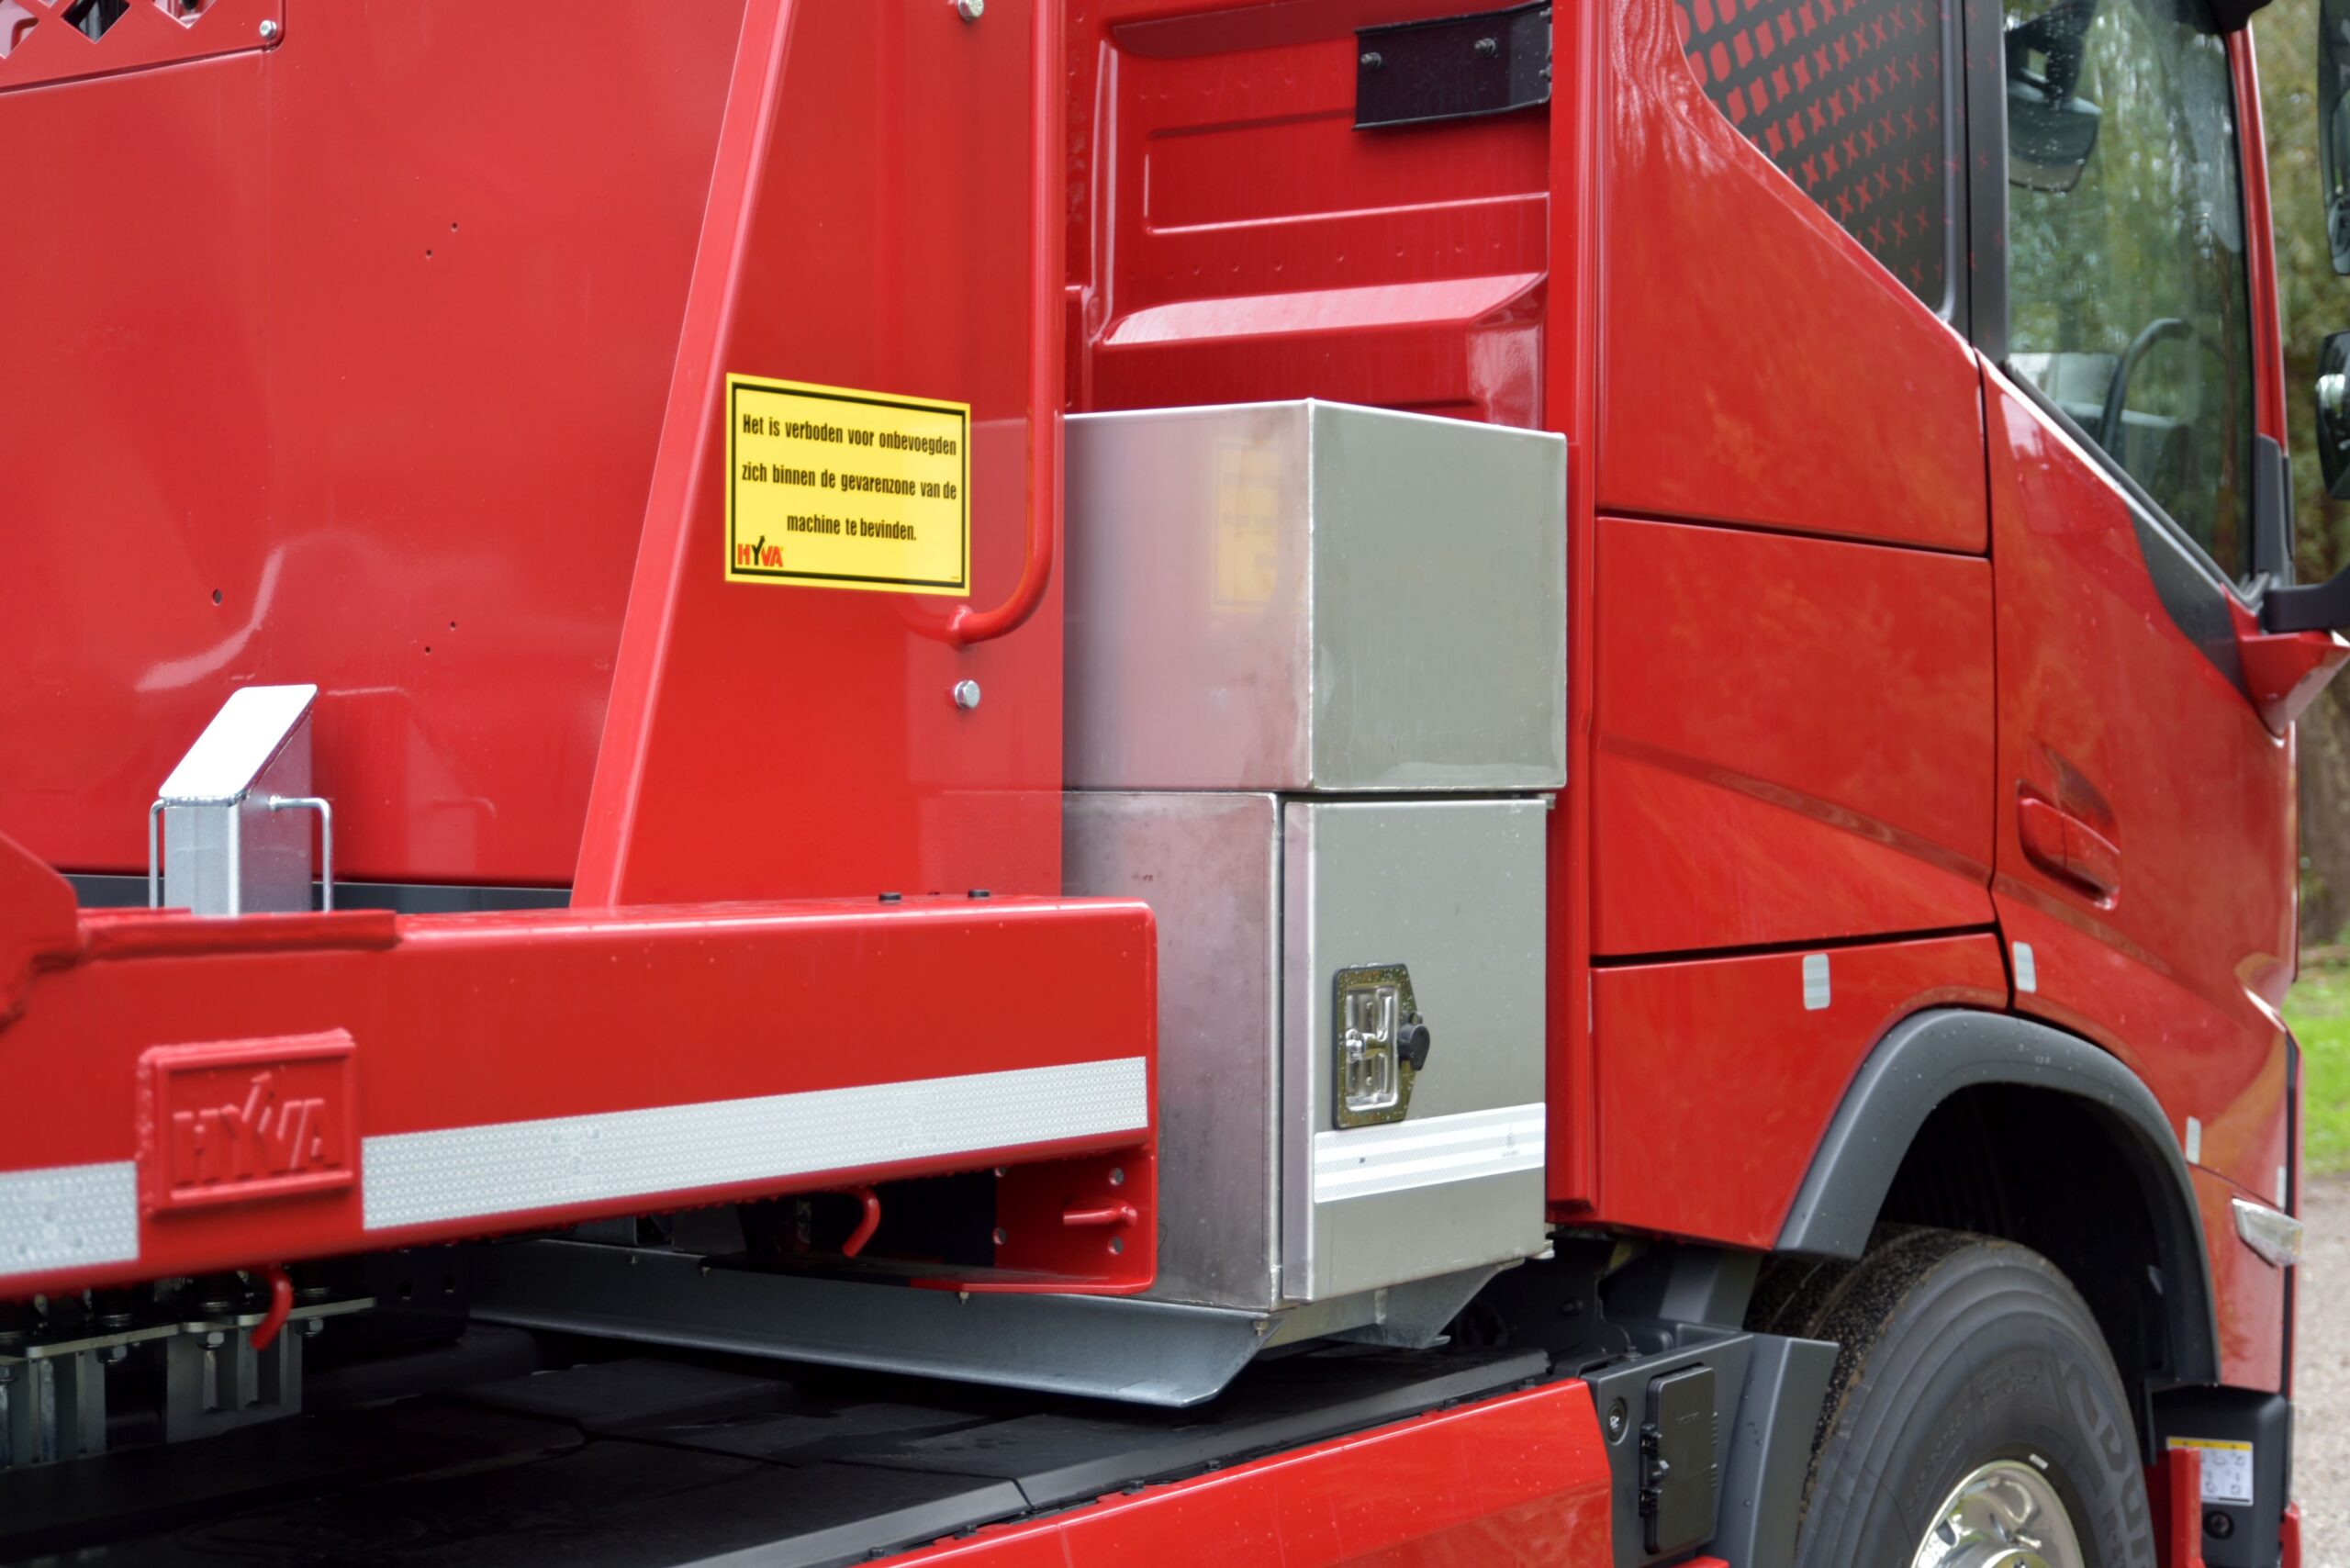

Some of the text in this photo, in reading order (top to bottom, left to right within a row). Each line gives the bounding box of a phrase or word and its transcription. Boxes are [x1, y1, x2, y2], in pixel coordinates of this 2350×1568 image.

[743, 413, 957, 455] Het is verboden voor onbevoegden
[741, 461, 957, 500] zich binnen de gevarenzone van de
[787, 514, 917, 542] machine te bevinden.
[737, 534, 784, 567] HYVA
